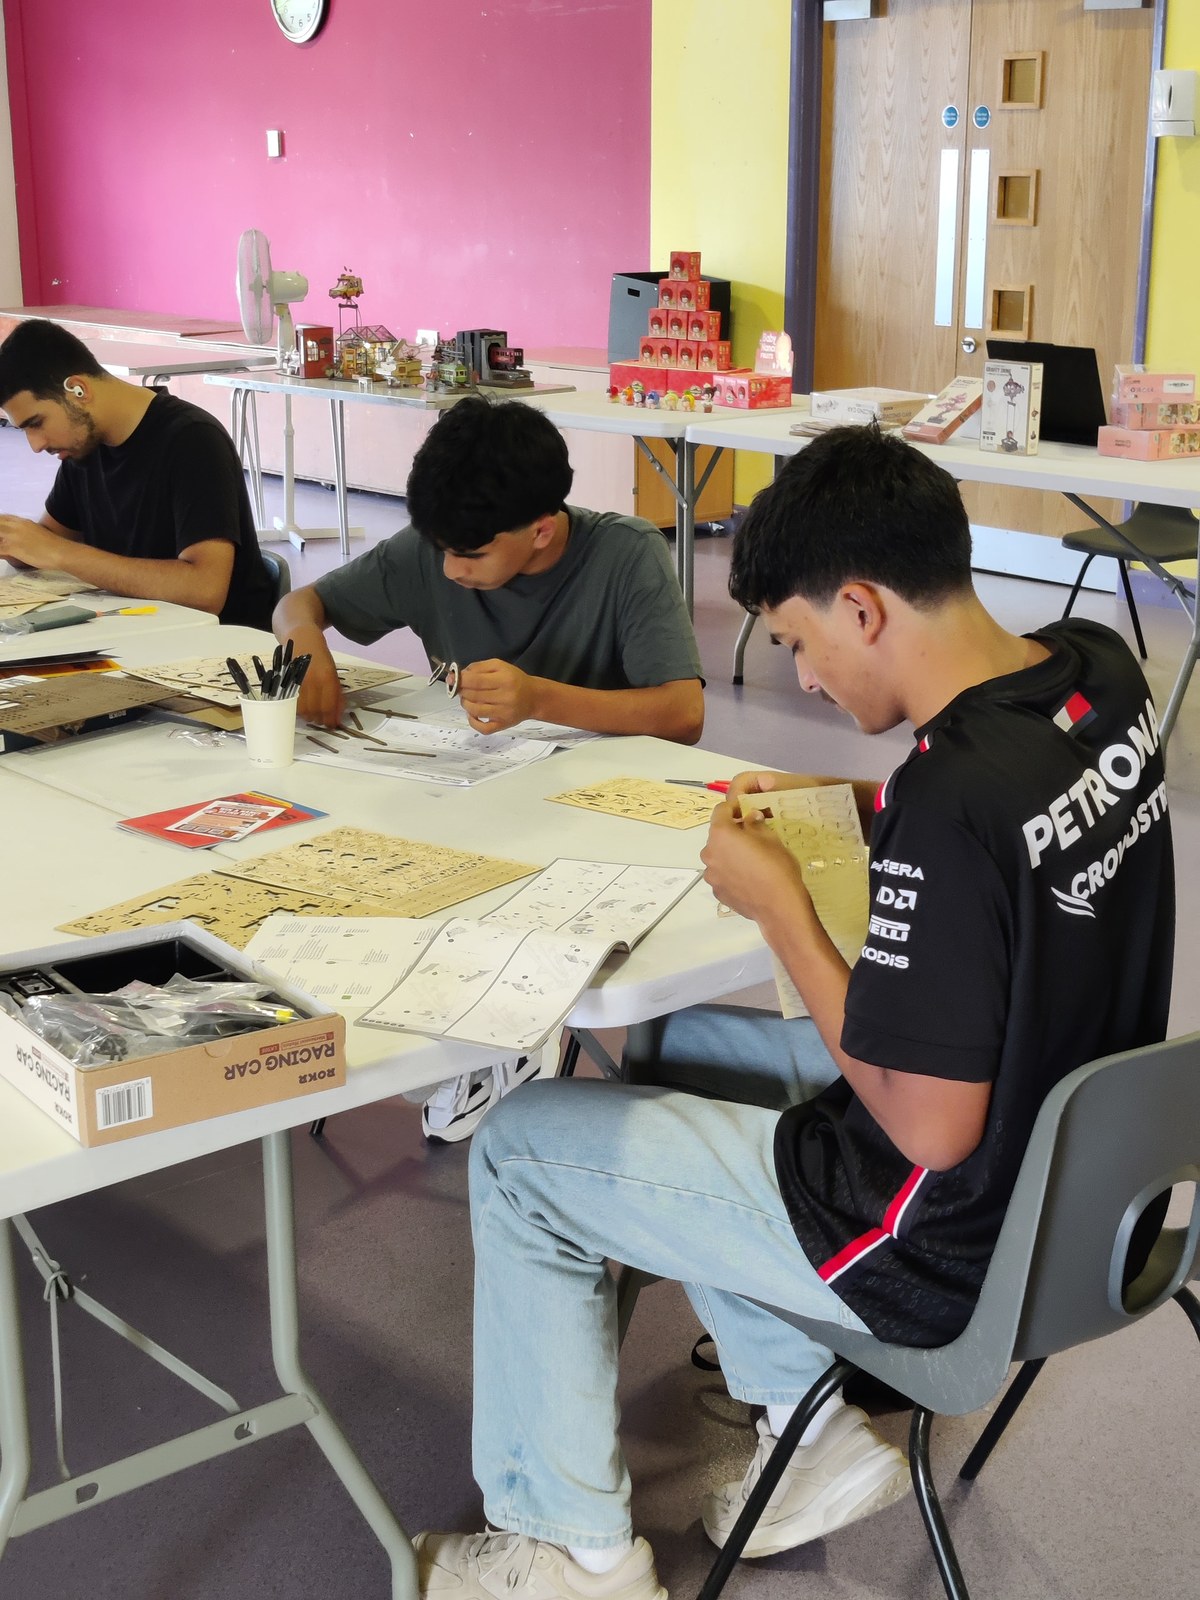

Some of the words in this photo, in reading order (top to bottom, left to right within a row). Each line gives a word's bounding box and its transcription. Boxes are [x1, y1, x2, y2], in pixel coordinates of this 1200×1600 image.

[869, 914, 911, 942] ELLI
[15, 1043, 34, 1072] CAR
[224, 1059, 262, 1081] CAR
[265, 1042, 335, 1071] RACING
[35, 1060, 71, 1102] RACING
[298, 1067, 336, 1084] ROKR
